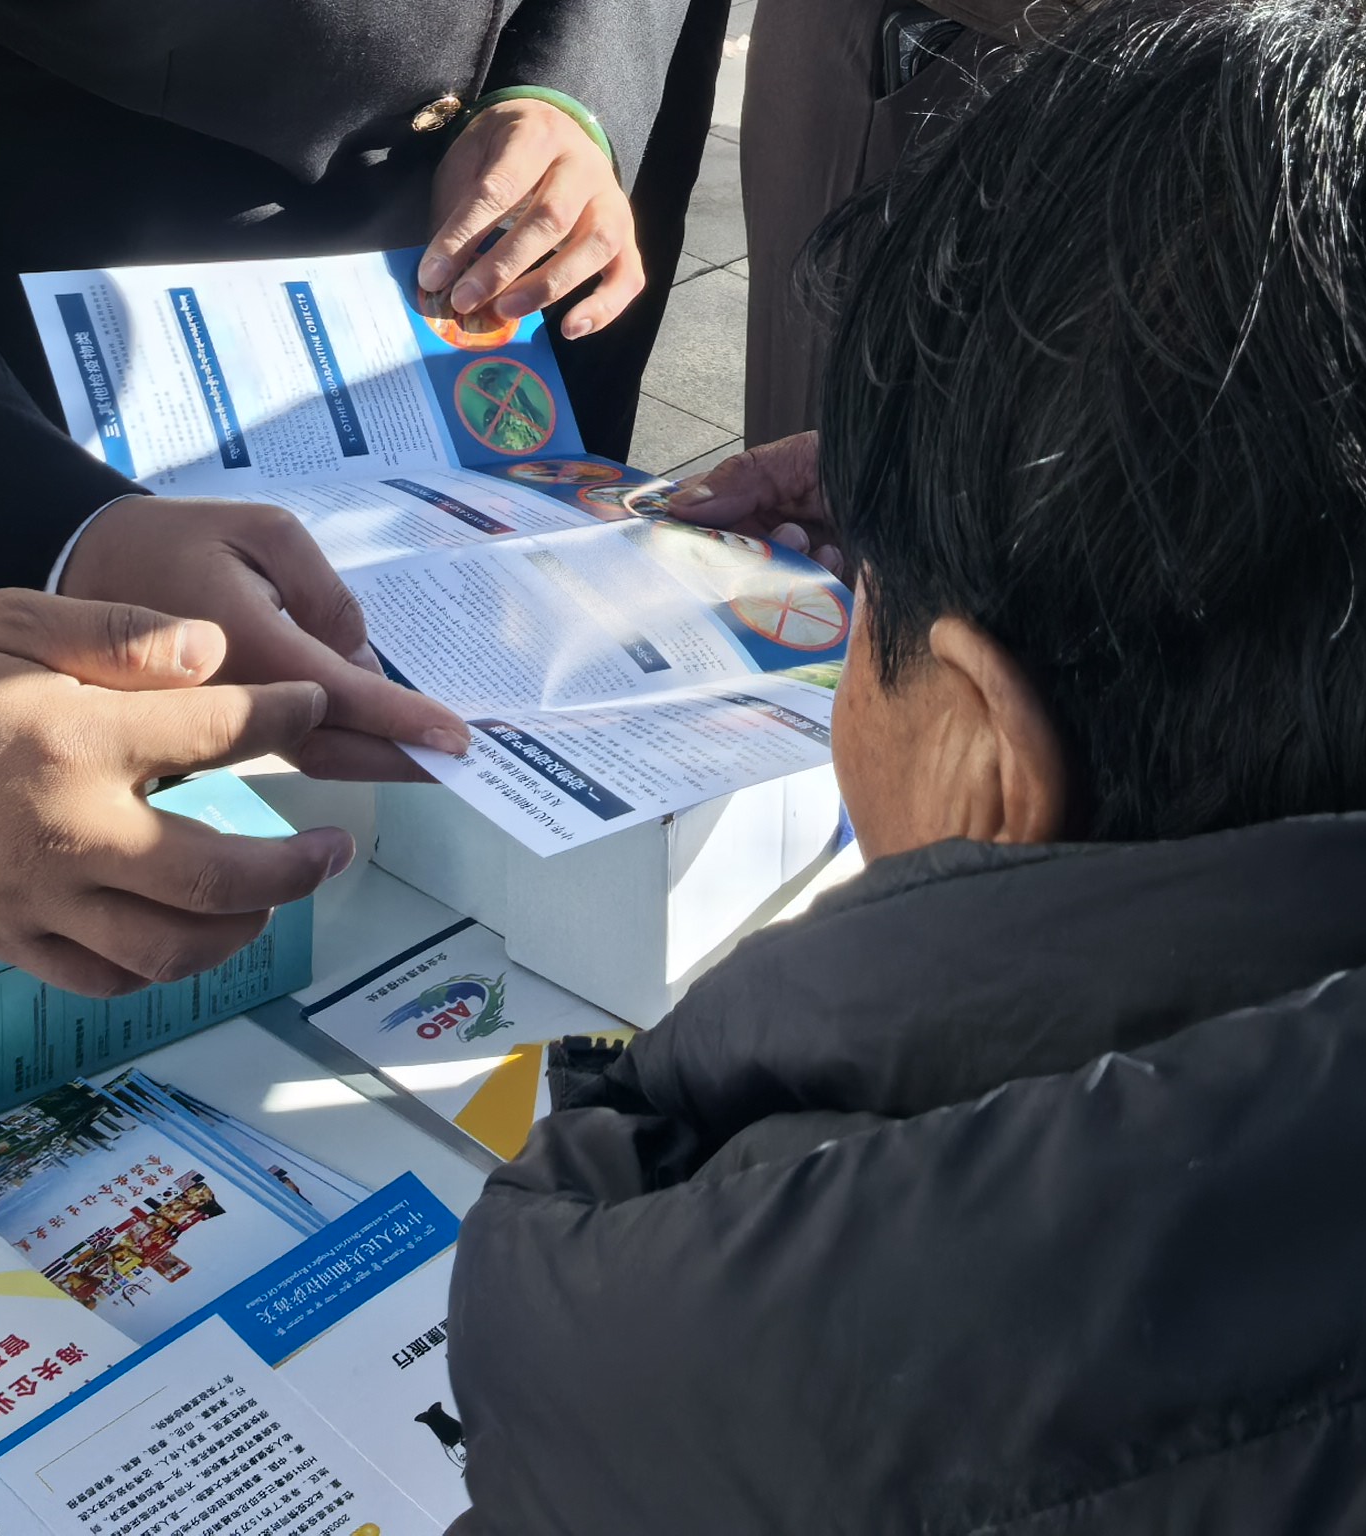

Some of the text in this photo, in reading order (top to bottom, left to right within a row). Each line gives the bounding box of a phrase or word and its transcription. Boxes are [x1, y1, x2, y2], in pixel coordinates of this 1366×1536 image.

[73, 331, 121, 436] 三、其他检疫物类
[310, 334, 340, 396] QUARANTINE
[333, 397, 352, 431] OTHER
[488, 722, 600, 801] 一、动物及动物产品类
[416, 1000, 471, 1039] AEO
[255, 1211, 423, 1323] 中华人民共和国拉萨海关
